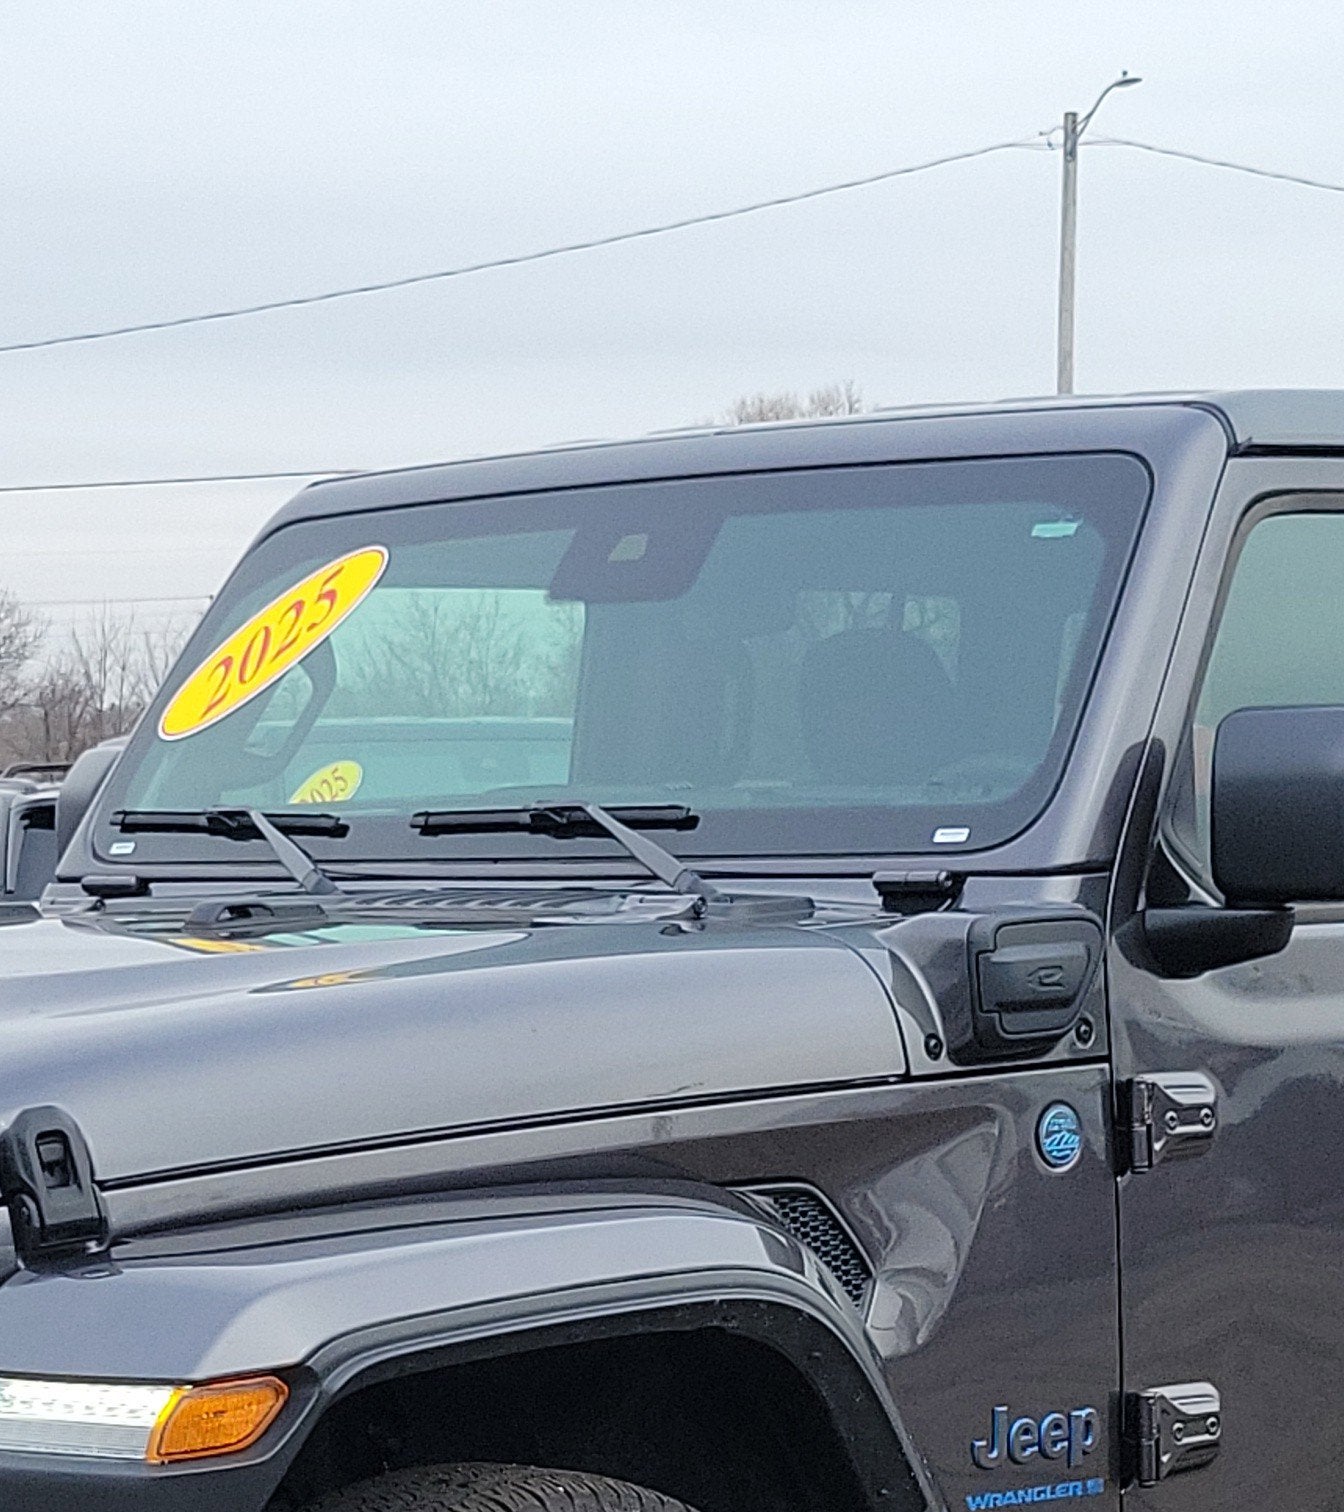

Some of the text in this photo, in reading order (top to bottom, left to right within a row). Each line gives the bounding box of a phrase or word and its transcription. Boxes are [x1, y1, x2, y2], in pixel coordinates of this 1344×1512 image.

[199, 565, 345, 721] 2025
[299, 767, 349, 803] 025
[971, 1404, 1102, 1470] Jeep
[964, 1479, 1084, 1512] WRANGLER
